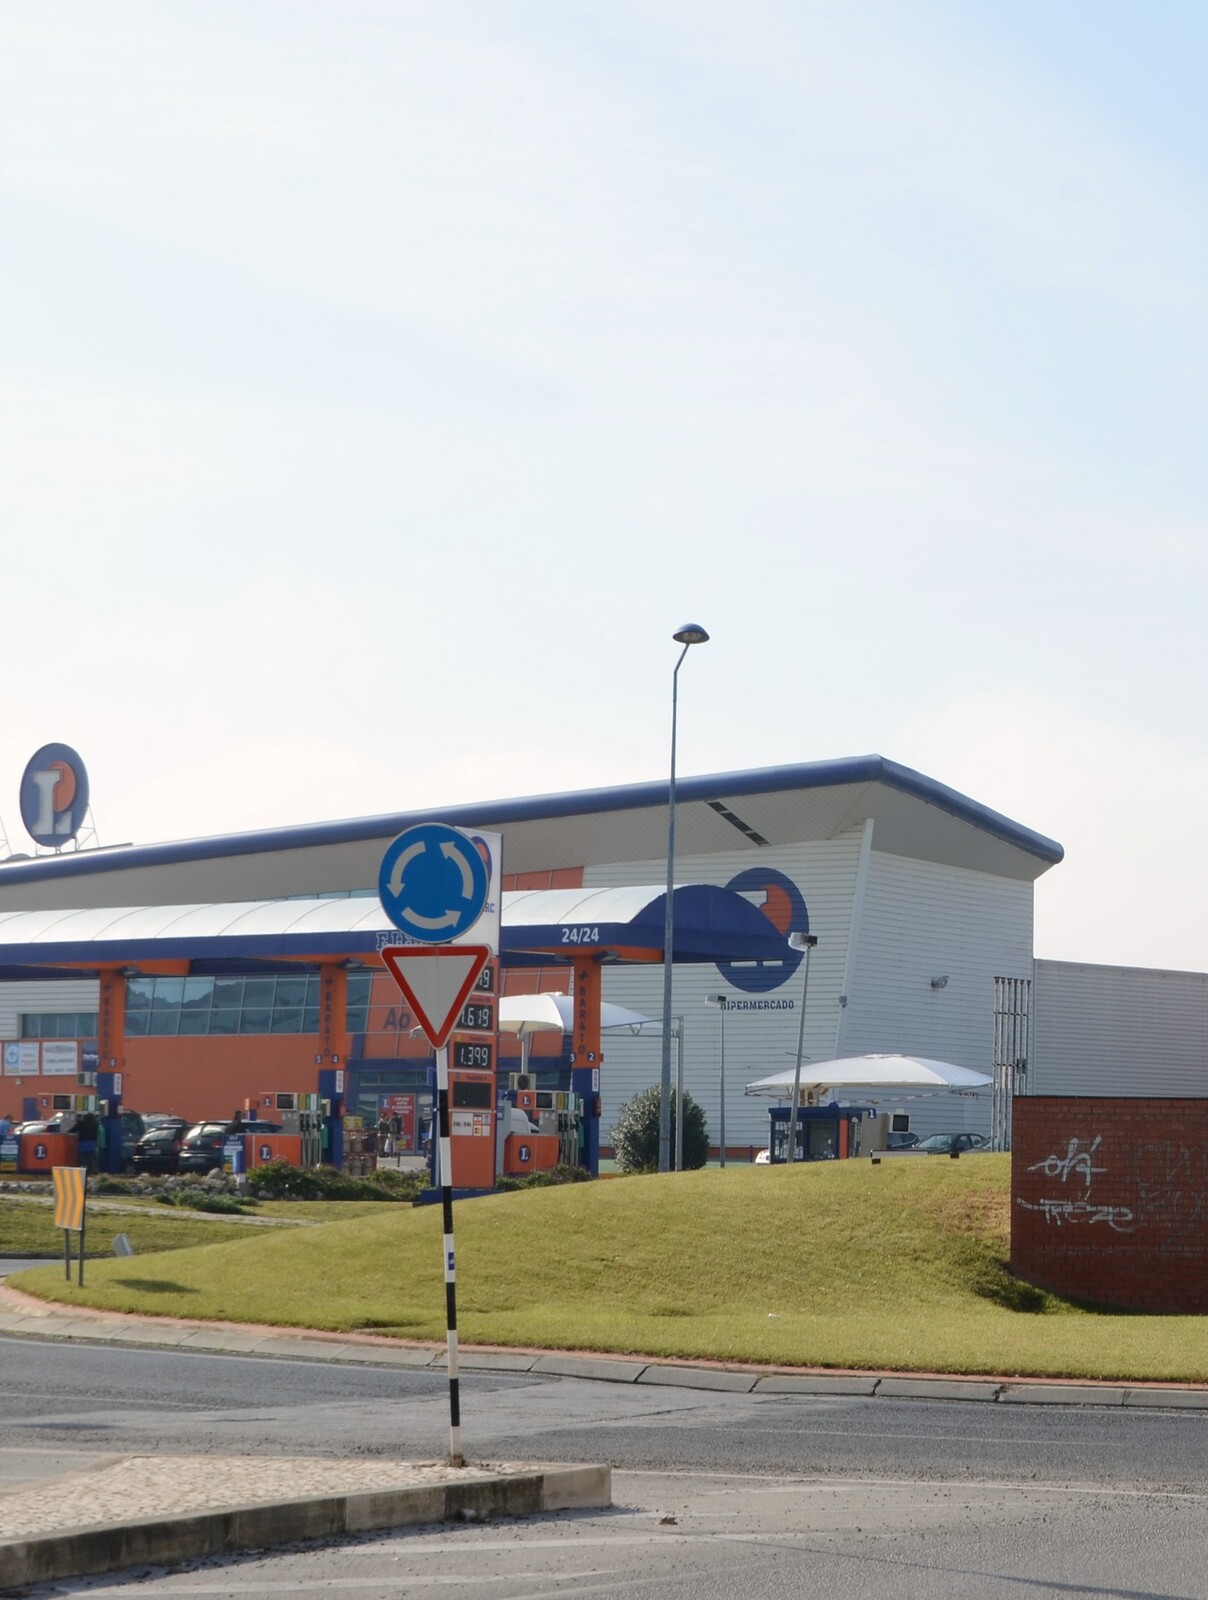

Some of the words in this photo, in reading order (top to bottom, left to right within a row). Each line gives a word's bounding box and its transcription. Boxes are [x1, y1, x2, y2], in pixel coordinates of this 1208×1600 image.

[561, 928, 600, 943] 24/24
[578, 986, 587, 1055] BARATO
[461, 1046, 488, 1066] 1.399
[570, 1053, 576, 1062] 3
[588, 1053, 595, 1061] 2
[868, 1109, 875, 1118] 1
